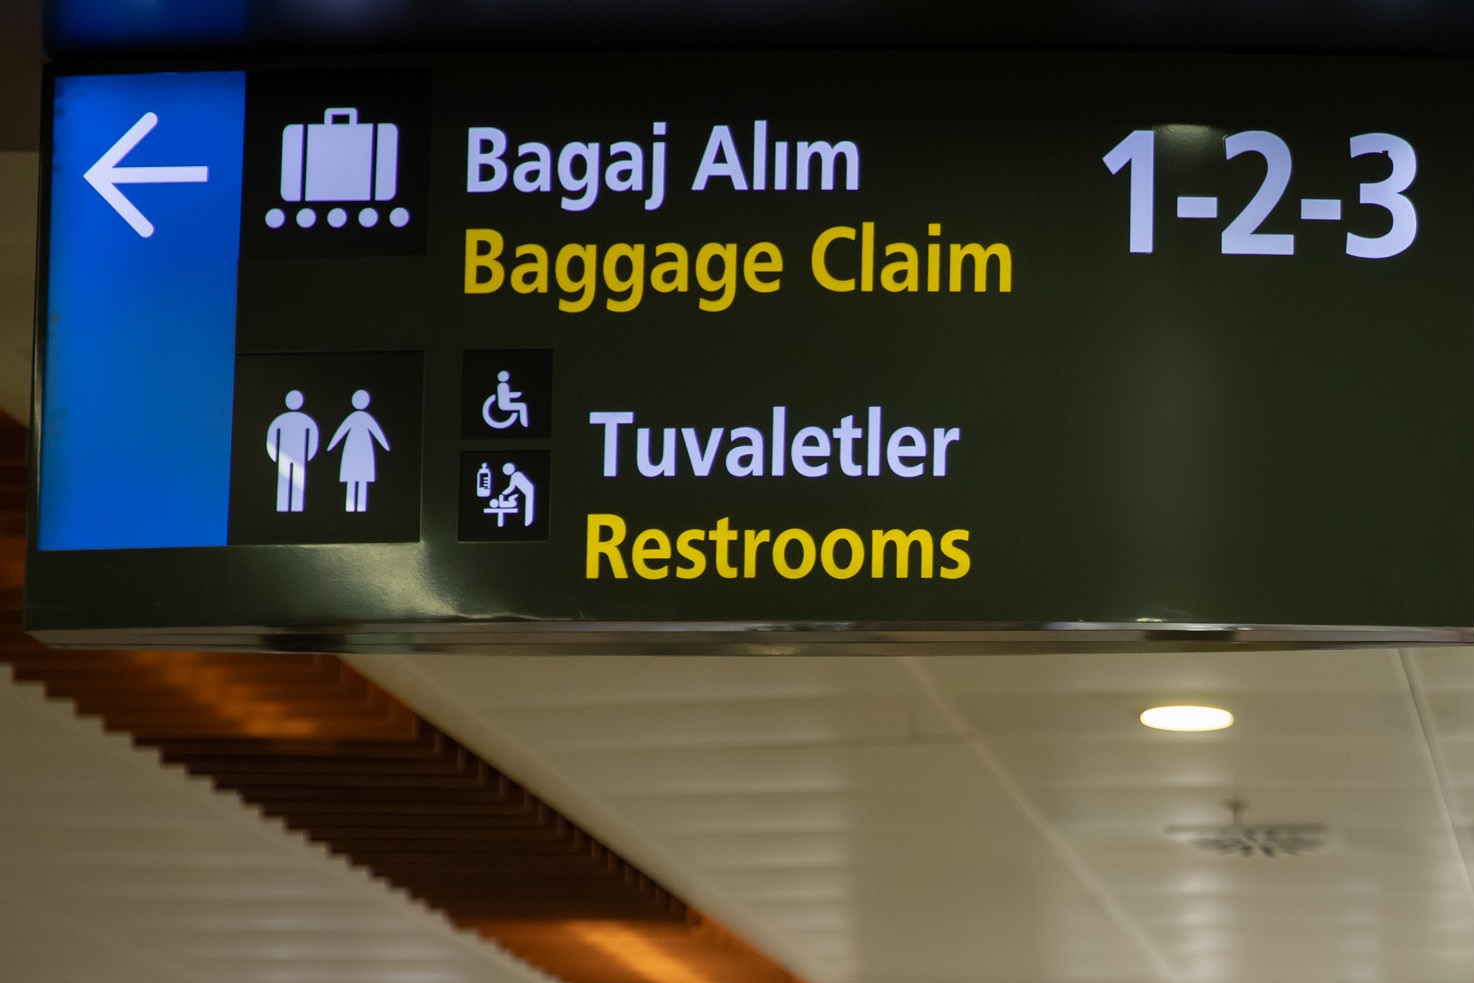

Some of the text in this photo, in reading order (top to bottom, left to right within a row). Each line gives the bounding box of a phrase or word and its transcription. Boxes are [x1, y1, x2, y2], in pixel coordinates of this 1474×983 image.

[467, 121, 861, 213] Bagaj Alım
[1103, 129, 1419, 260] 1-2-3
[465, 222, 1013, 314] Baggage Claim
[590, 407, 962, 479] Tuvaletler
[586, 514, 972, 581] Restrooms
